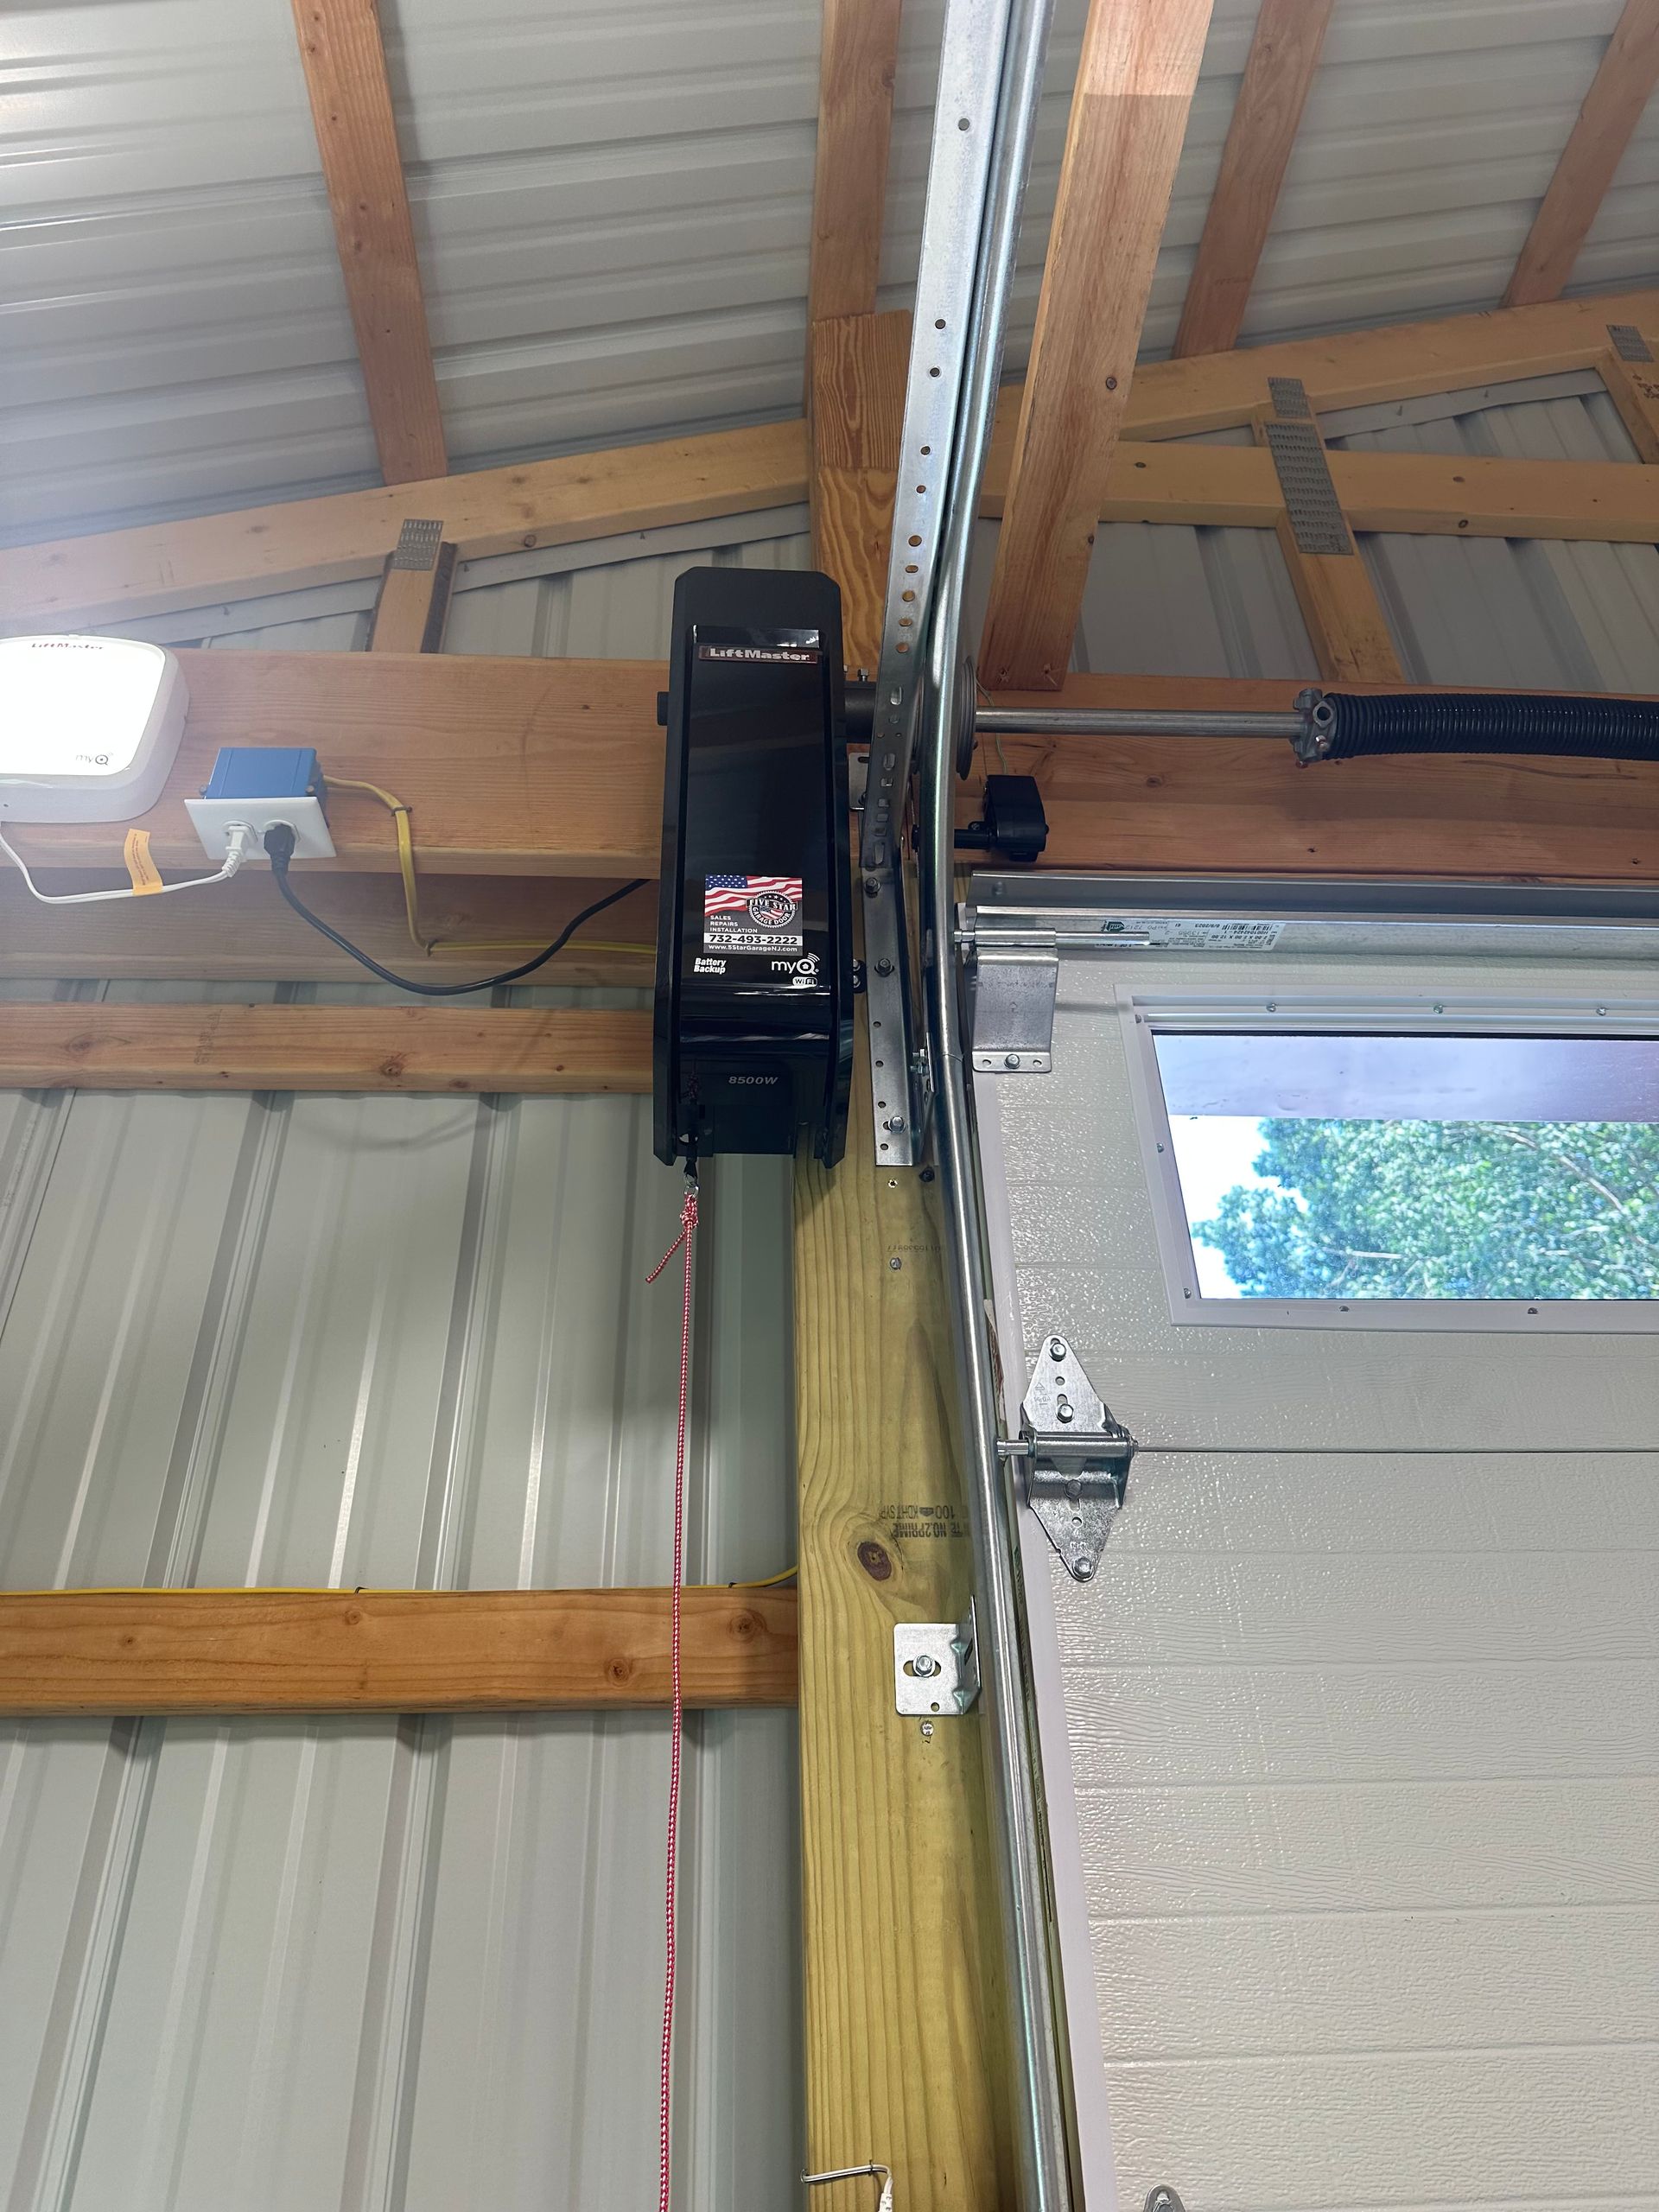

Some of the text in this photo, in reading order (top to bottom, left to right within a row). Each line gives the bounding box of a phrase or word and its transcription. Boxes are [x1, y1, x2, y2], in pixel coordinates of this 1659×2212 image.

[709, 648, 810, 661] LiftMaster
[749, 898, 797, 911] FIVE STAR
[752, 906, 791, 925] GARAGE DOOR
[709, 934, 798, 944] 732-493-2222
[695, 957, 727, 967] Battery
[771, 958, 817, 975] myQ
[693, 965, 727, 975] Backup
[728, 1076, 779, 1084] 8500W
